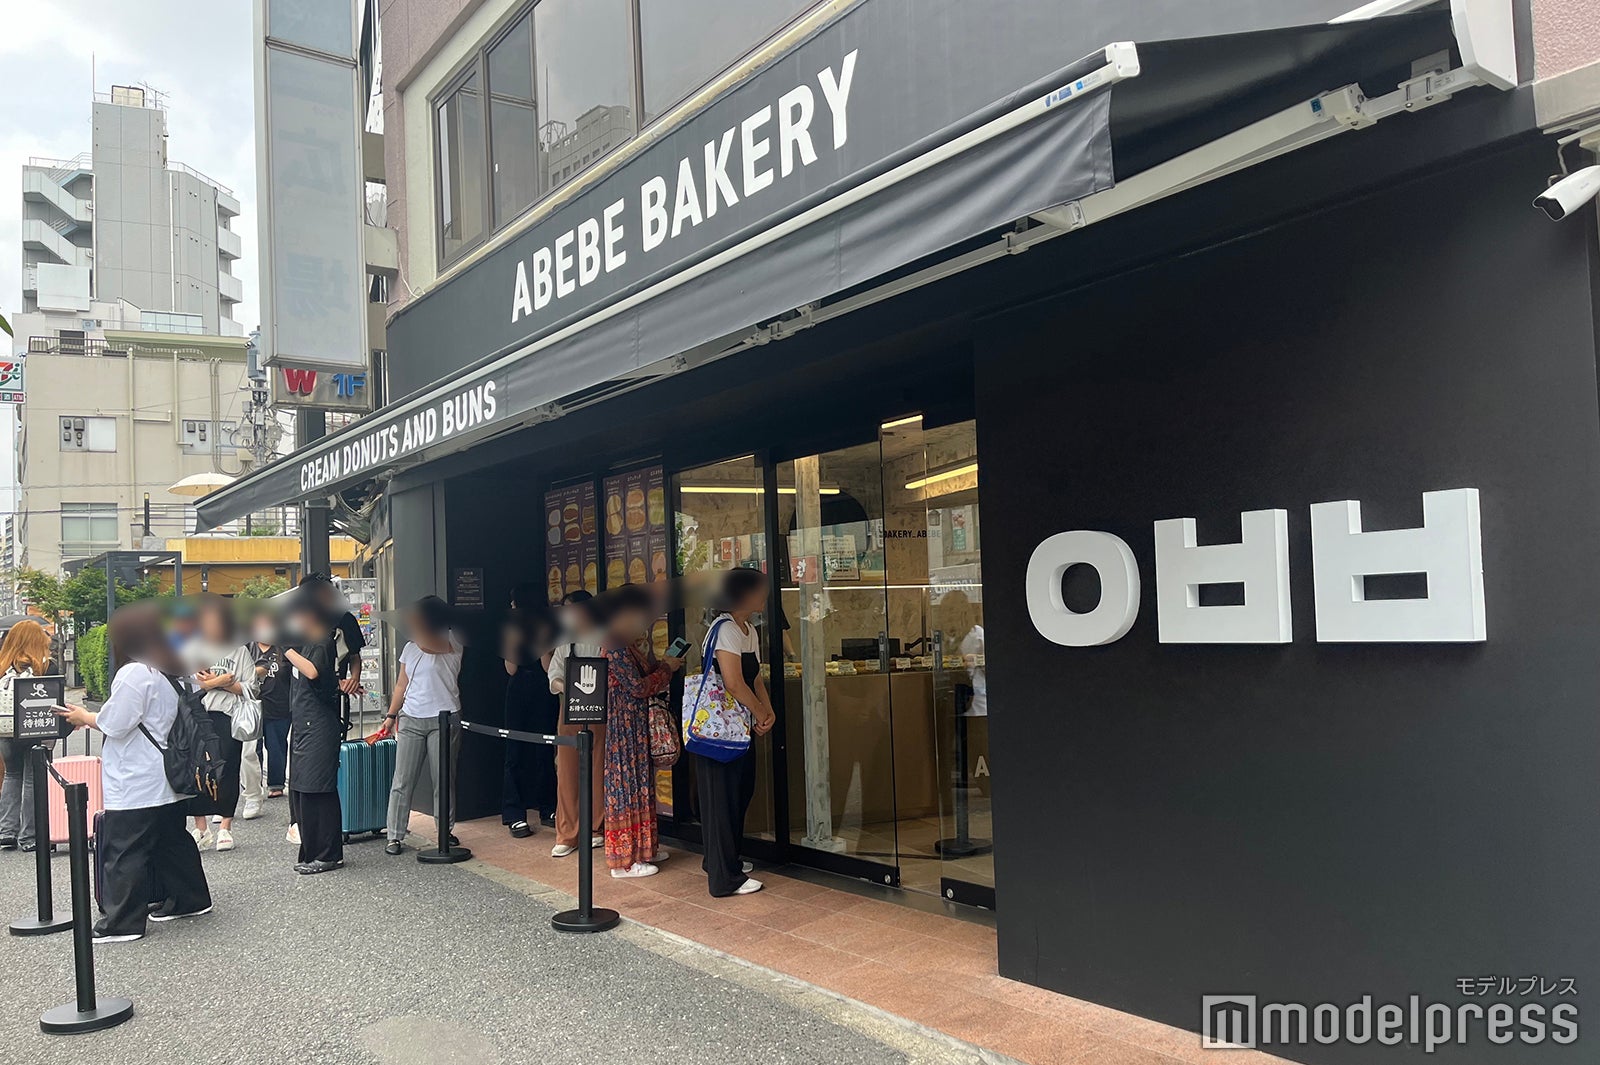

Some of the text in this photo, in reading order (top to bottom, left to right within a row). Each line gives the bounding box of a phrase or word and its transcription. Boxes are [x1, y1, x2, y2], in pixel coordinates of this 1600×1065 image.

[511, 48, 858, 324] ABEBE BAKERY
[332, 371, 367, 396] 1F
[300, 380, 497, 491] CREAM DONUTS AND BUNS
[23, 717, 56, 728] 待機列
